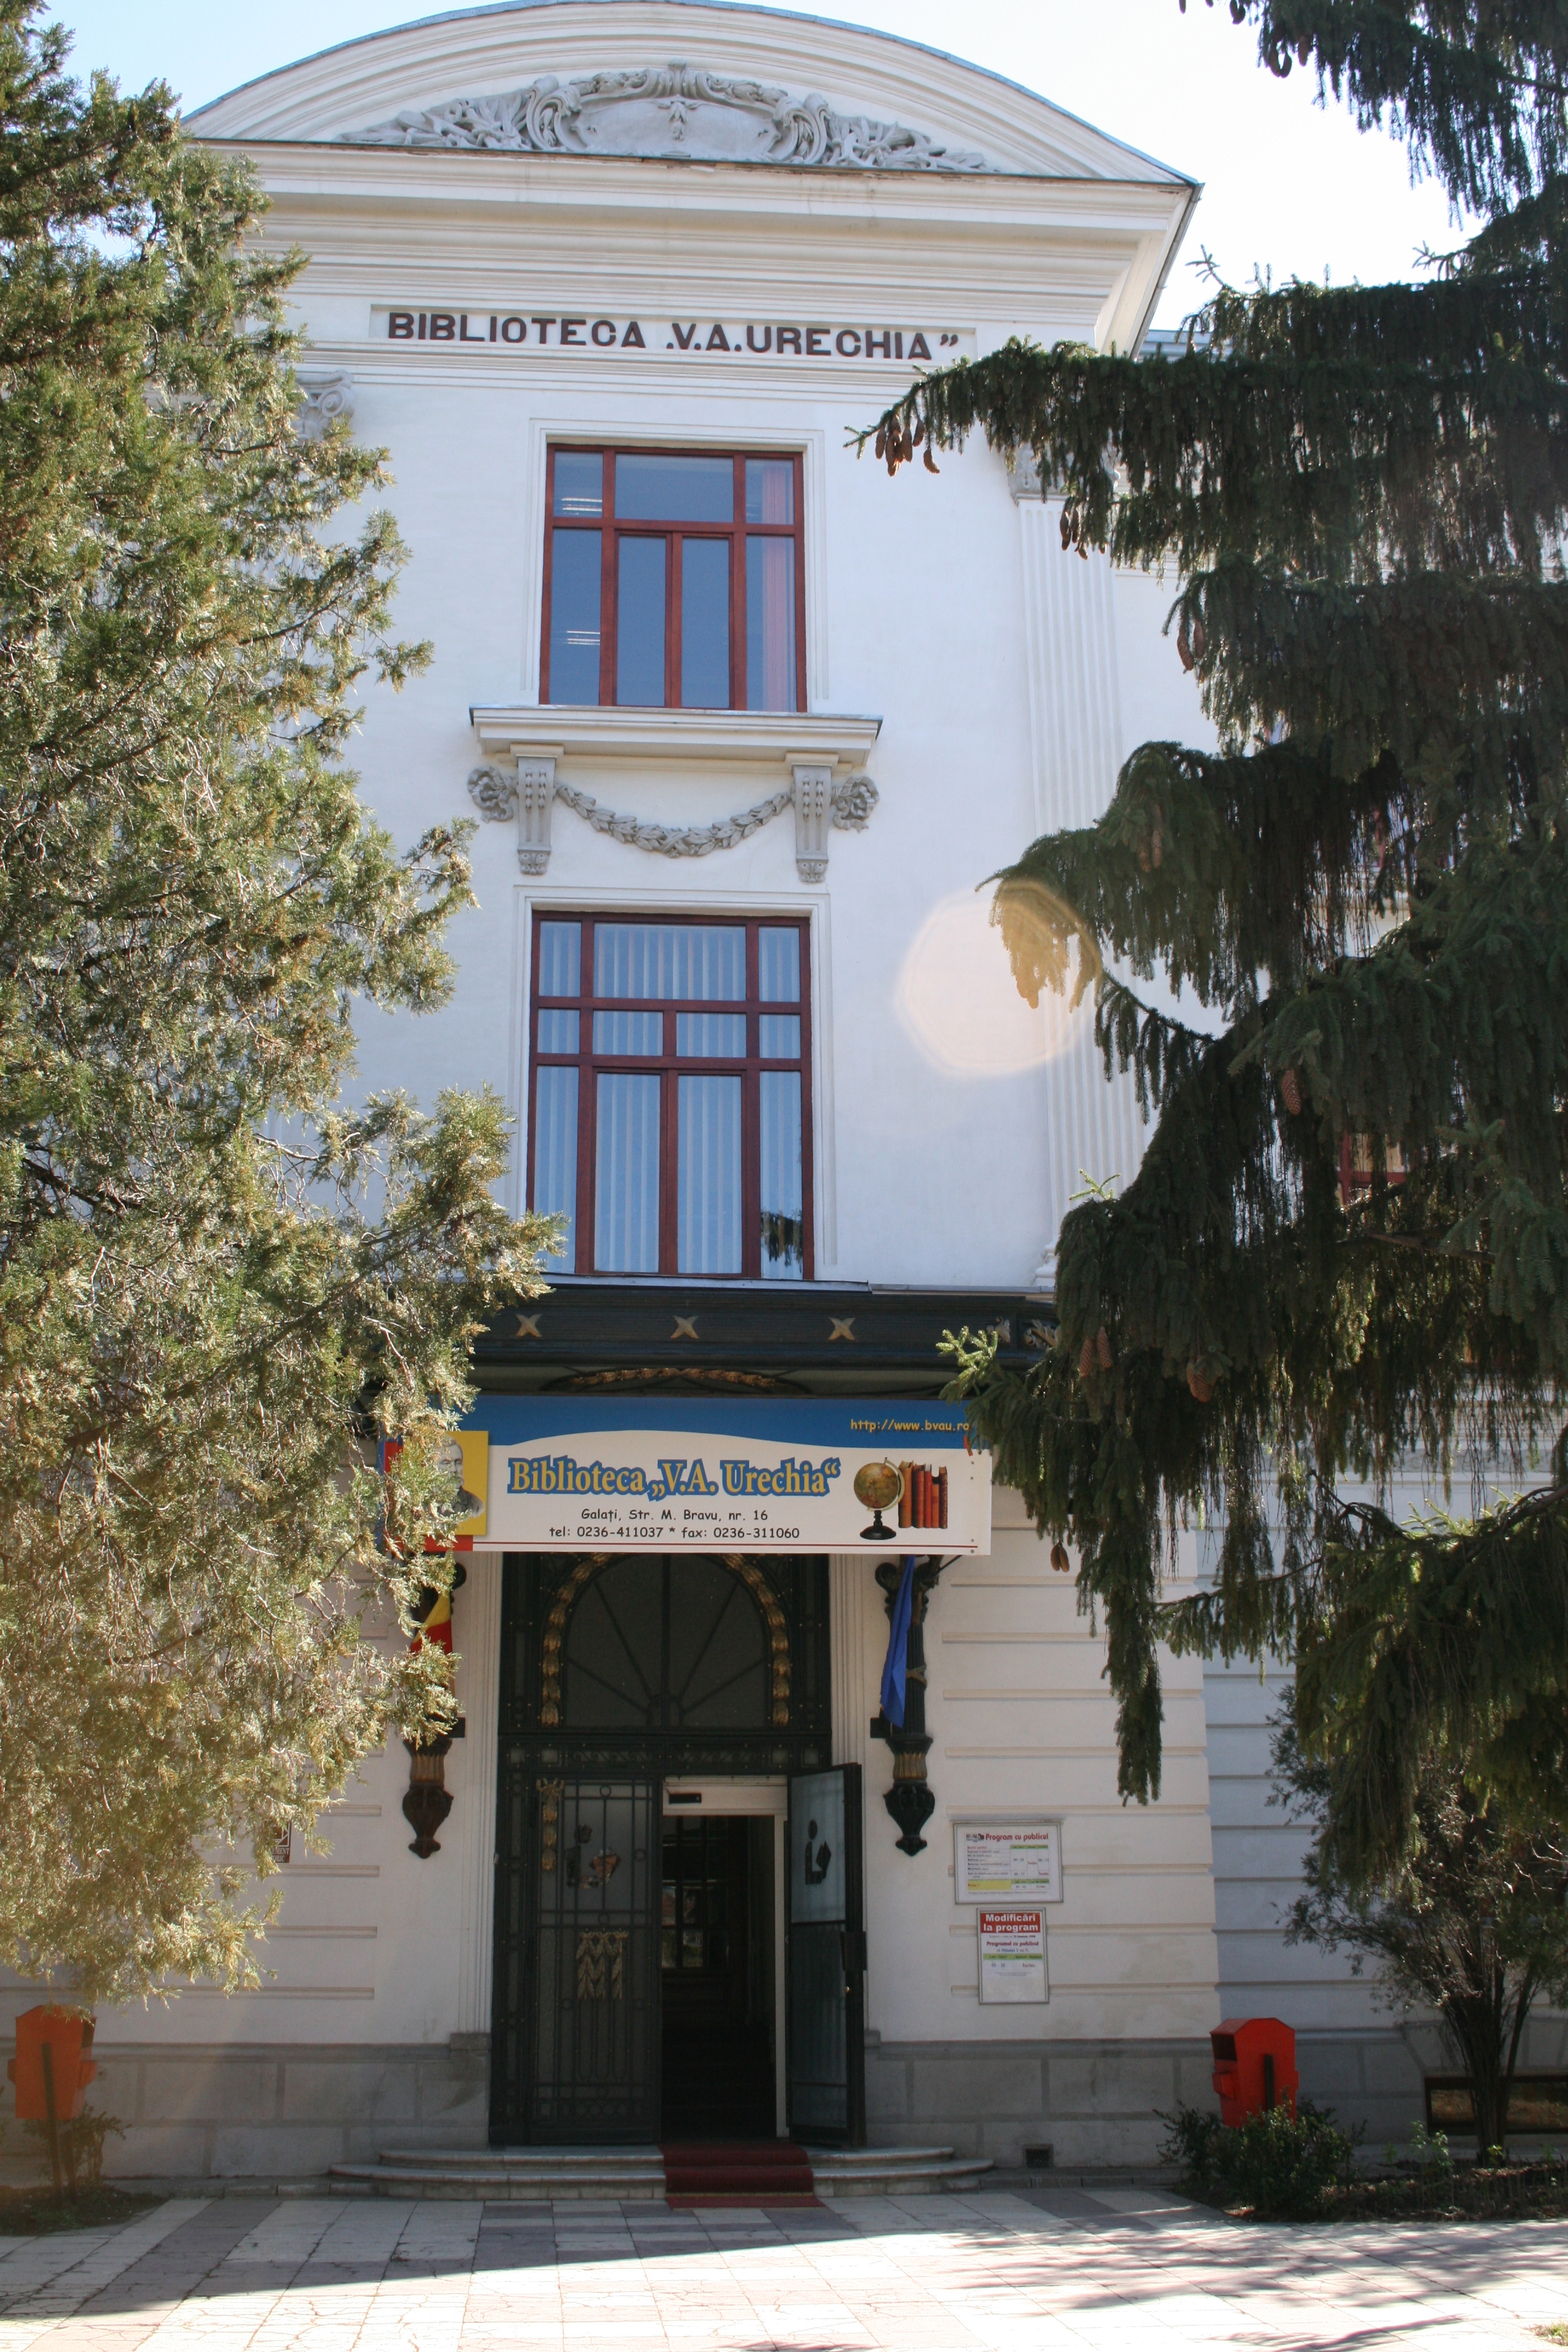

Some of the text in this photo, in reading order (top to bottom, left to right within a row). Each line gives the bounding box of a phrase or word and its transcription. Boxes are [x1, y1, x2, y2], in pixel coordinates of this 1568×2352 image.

[388, 312, 646, 349] BIBLIOTECA
[511, 1459, 645, 1492] Biblioteca
[629, 1509, 654, 1521] Str.
[661, 1510, 676, 1521] M.
[683, 1510, 722, 1523] Bravu,
[753, 1510, 768, 1521] 16
[549, 1527, 571, 1538] tel:
[577, 1526, 664, 1538] 0236-411037
[681, 1527, 708, 1538] fax:
[713, 1527, 800, 1539] 0236-311060
[985, 1833, 1013, 1842] Program
[1023, 1832, 1048, 1842] publicul
[985, 1913, 1036, 1922] Modificări
[996, 1924, 1038, 1933] program
